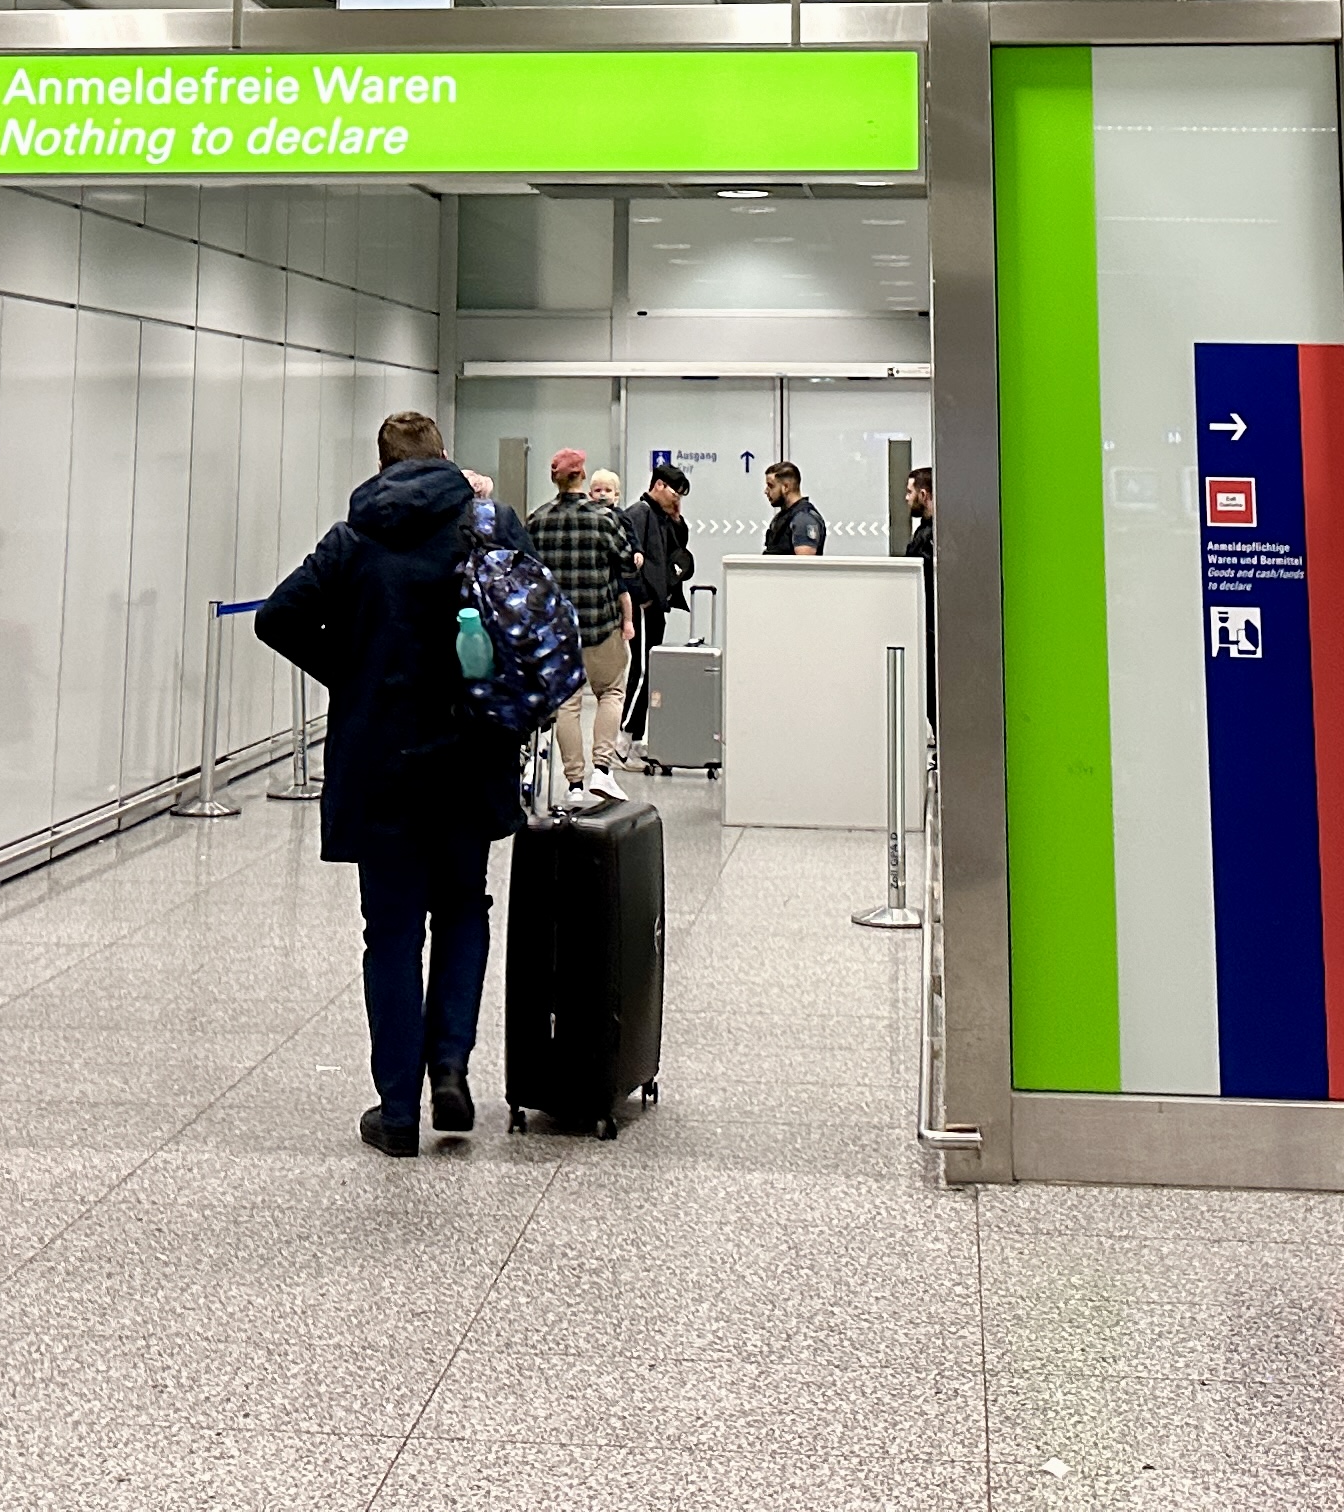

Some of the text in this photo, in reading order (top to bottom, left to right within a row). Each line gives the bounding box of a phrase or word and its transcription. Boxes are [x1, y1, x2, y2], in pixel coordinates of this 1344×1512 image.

[1, 65, 457, 106] Anmeldefreie Waren
[0, 116, 409, 165] Nothing to declare
[676, 449, 718, 462] Ausgang
[1207, 541, 1291, 554] Anmeldepflichtige
[1207, 554, 1303, 566] Waren und Barmittel
[1207, 567, 1236, 578] Goods
[1236, 568, 1255, 578] and
[1208, 581, 1253, 591] to declare
